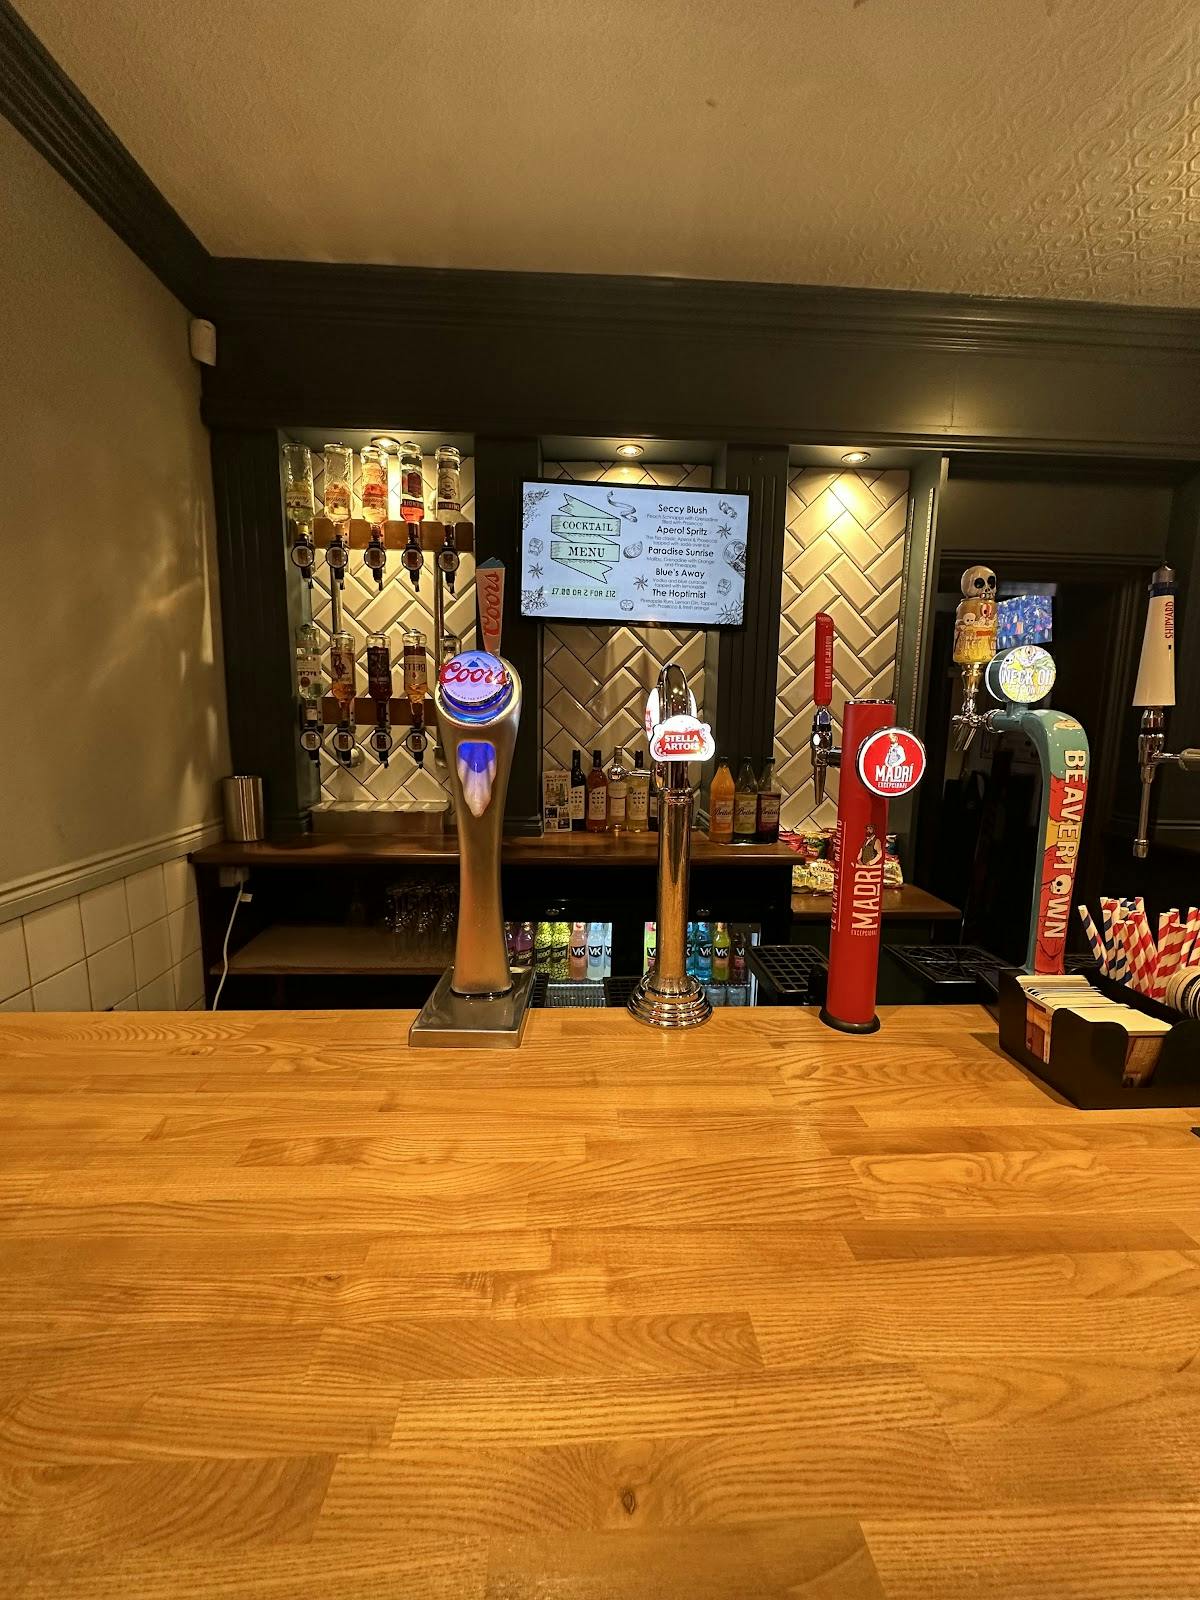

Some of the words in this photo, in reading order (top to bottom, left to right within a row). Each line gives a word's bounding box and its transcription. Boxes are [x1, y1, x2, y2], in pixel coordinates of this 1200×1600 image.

[658, 504, 684, 514] Seccy
[686, 505, 708, 514] Blush
[562, 521, 613, 532] COCKTAIL
[656, 526, 684, 534] Aperol
[686, 527, 708, 536] Spritz
[568, 546, 605, 558] MENU
[648, 546, 683, 556] Paradise
[686, 548, 714, 557] Sunrise
[656, 568, 679, 576] Blue's
[681, 570, 705, 579] Away
[653, 588, 667, 597] The
[668, 590, 706, 599] Hoptimist
[480, 572, 500, 636] Coors
[1164, 602, 1174, 639] SHIPYARD
[438, 662, 509, 685] Coors
[875, 763, 914, 782] MADRÍ
[850, 862, 882, 928] MADRÍ
[572, 948, 585, 956] VK
[589, 947, 601, 956] VK
[700, 947, 712, 956] VK
[715, 948, 728, 956] VK
